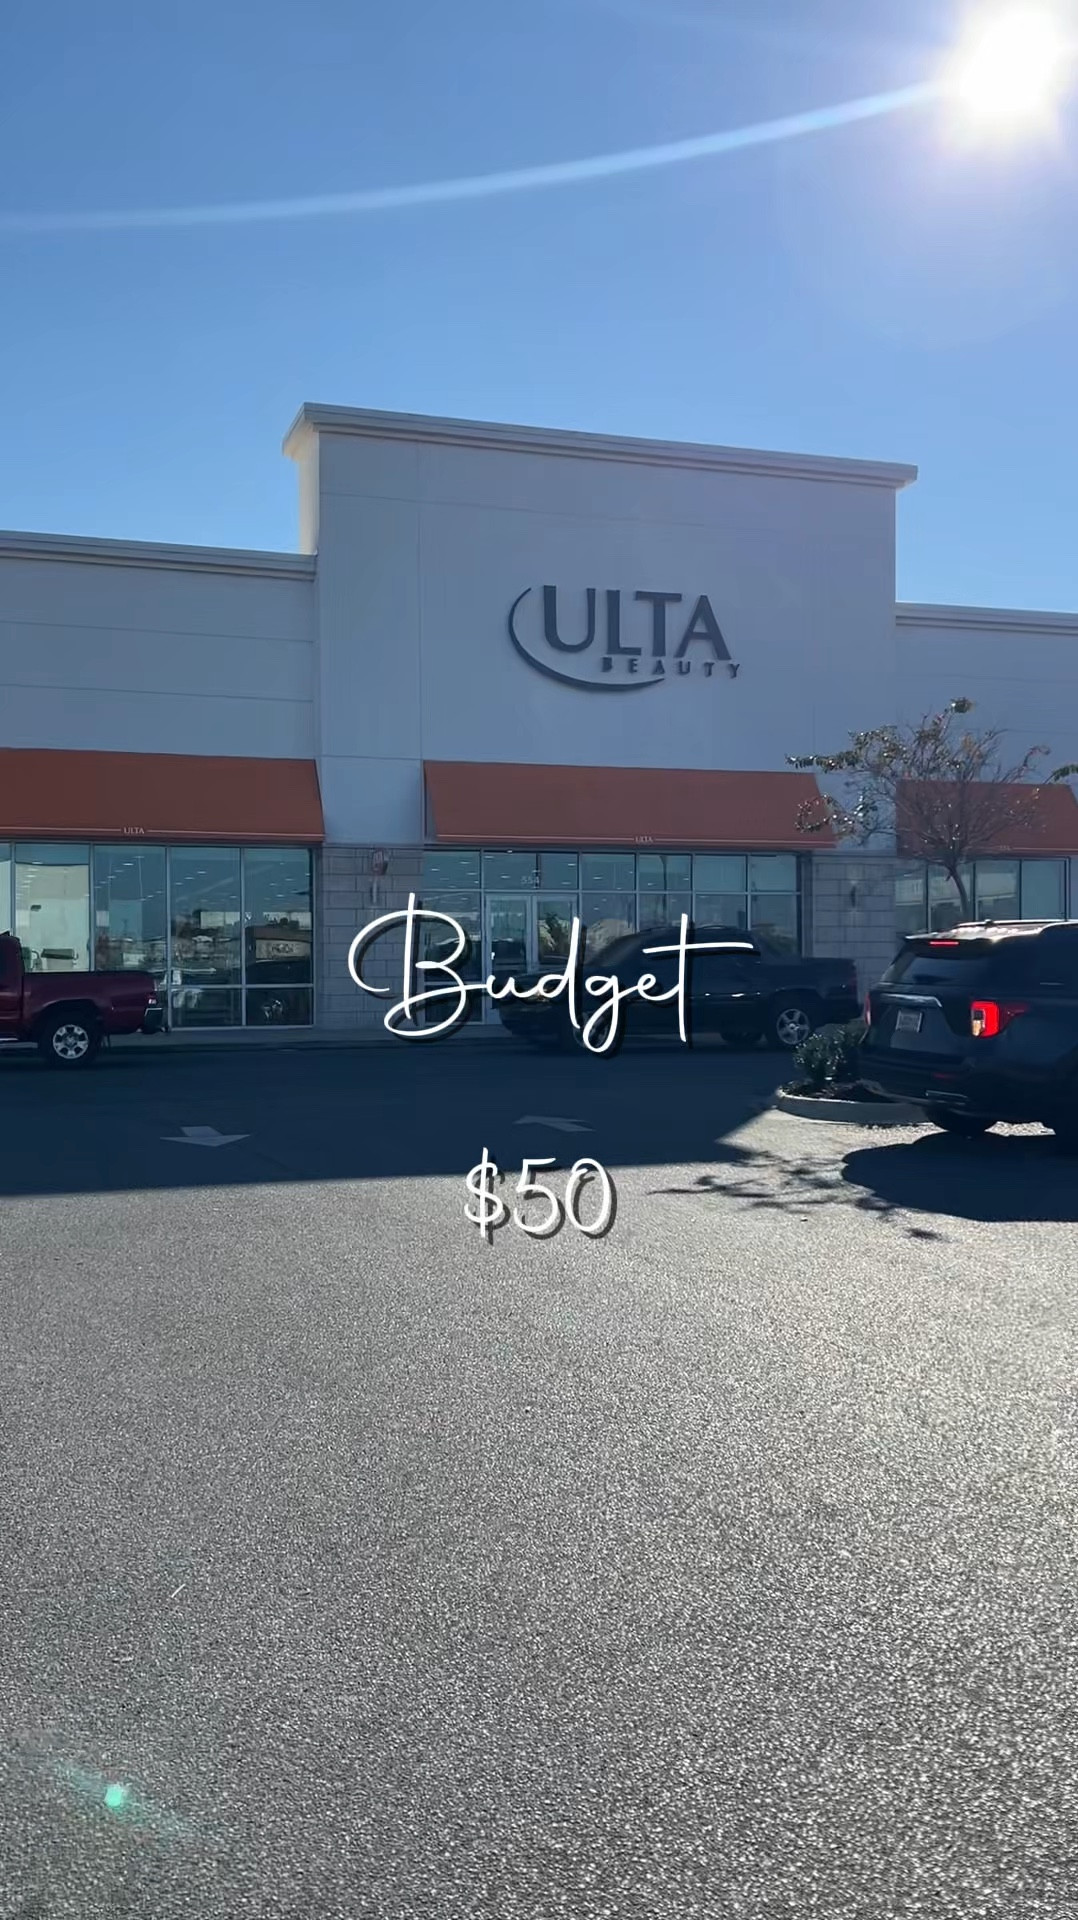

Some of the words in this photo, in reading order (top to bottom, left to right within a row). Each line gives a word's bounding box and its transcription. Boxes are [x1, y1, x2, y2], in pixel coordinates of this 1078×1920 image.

[542, 584, 732, 661] ULTA
[601, 656, 741, 679] BEAUTY
[123, 826, 145, 835] ULTA
